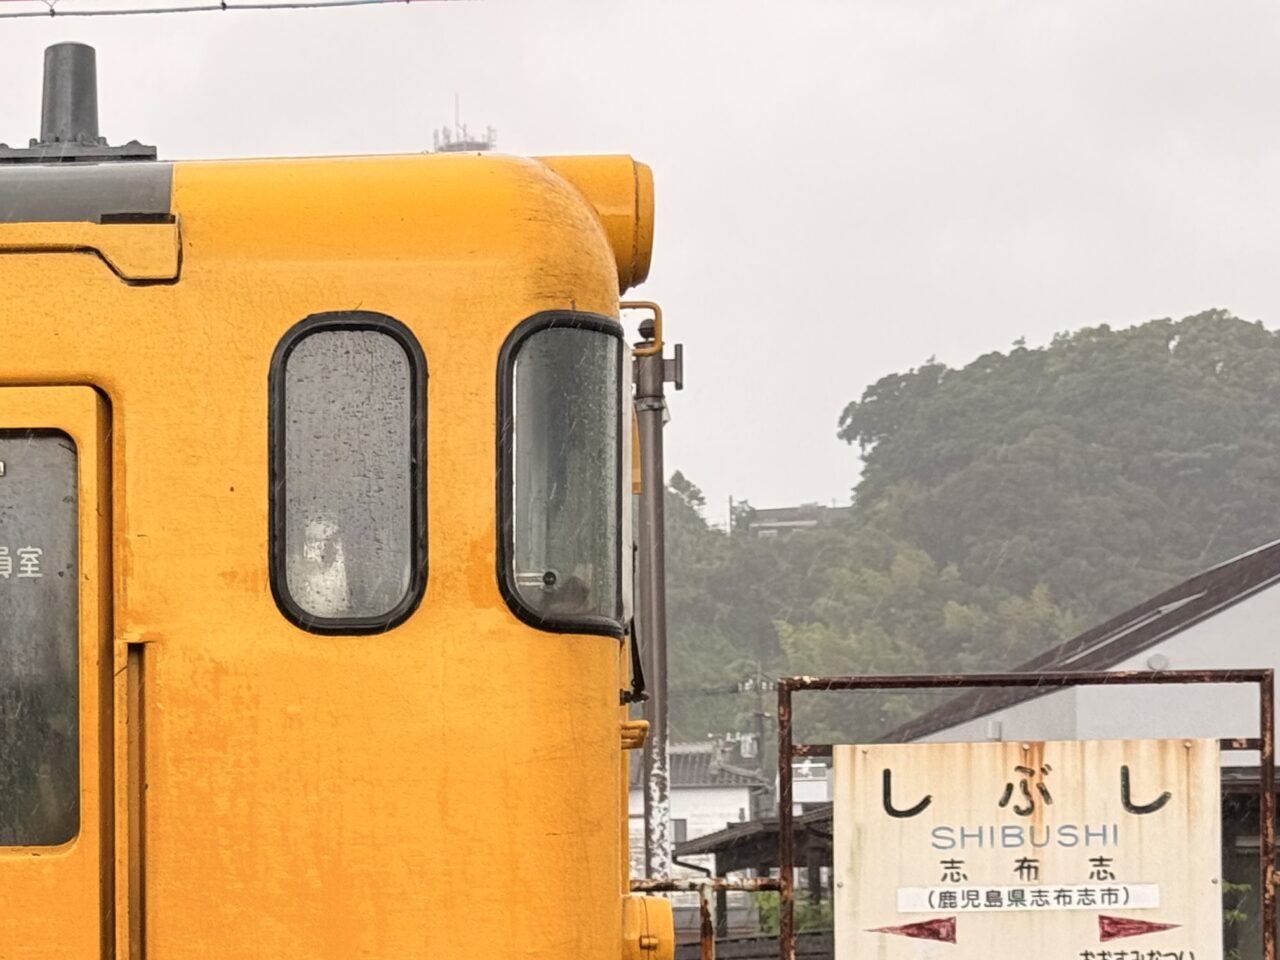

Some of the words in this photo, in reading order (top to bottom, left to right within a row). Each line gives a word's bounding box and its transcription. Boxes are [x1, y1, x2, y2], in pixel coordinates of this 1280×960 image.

[882, 764, 1172, 818] しぶし
[931, 823, 1119, 850] SHIBUSHI
[939, 856, 1117, 884] 志布志
